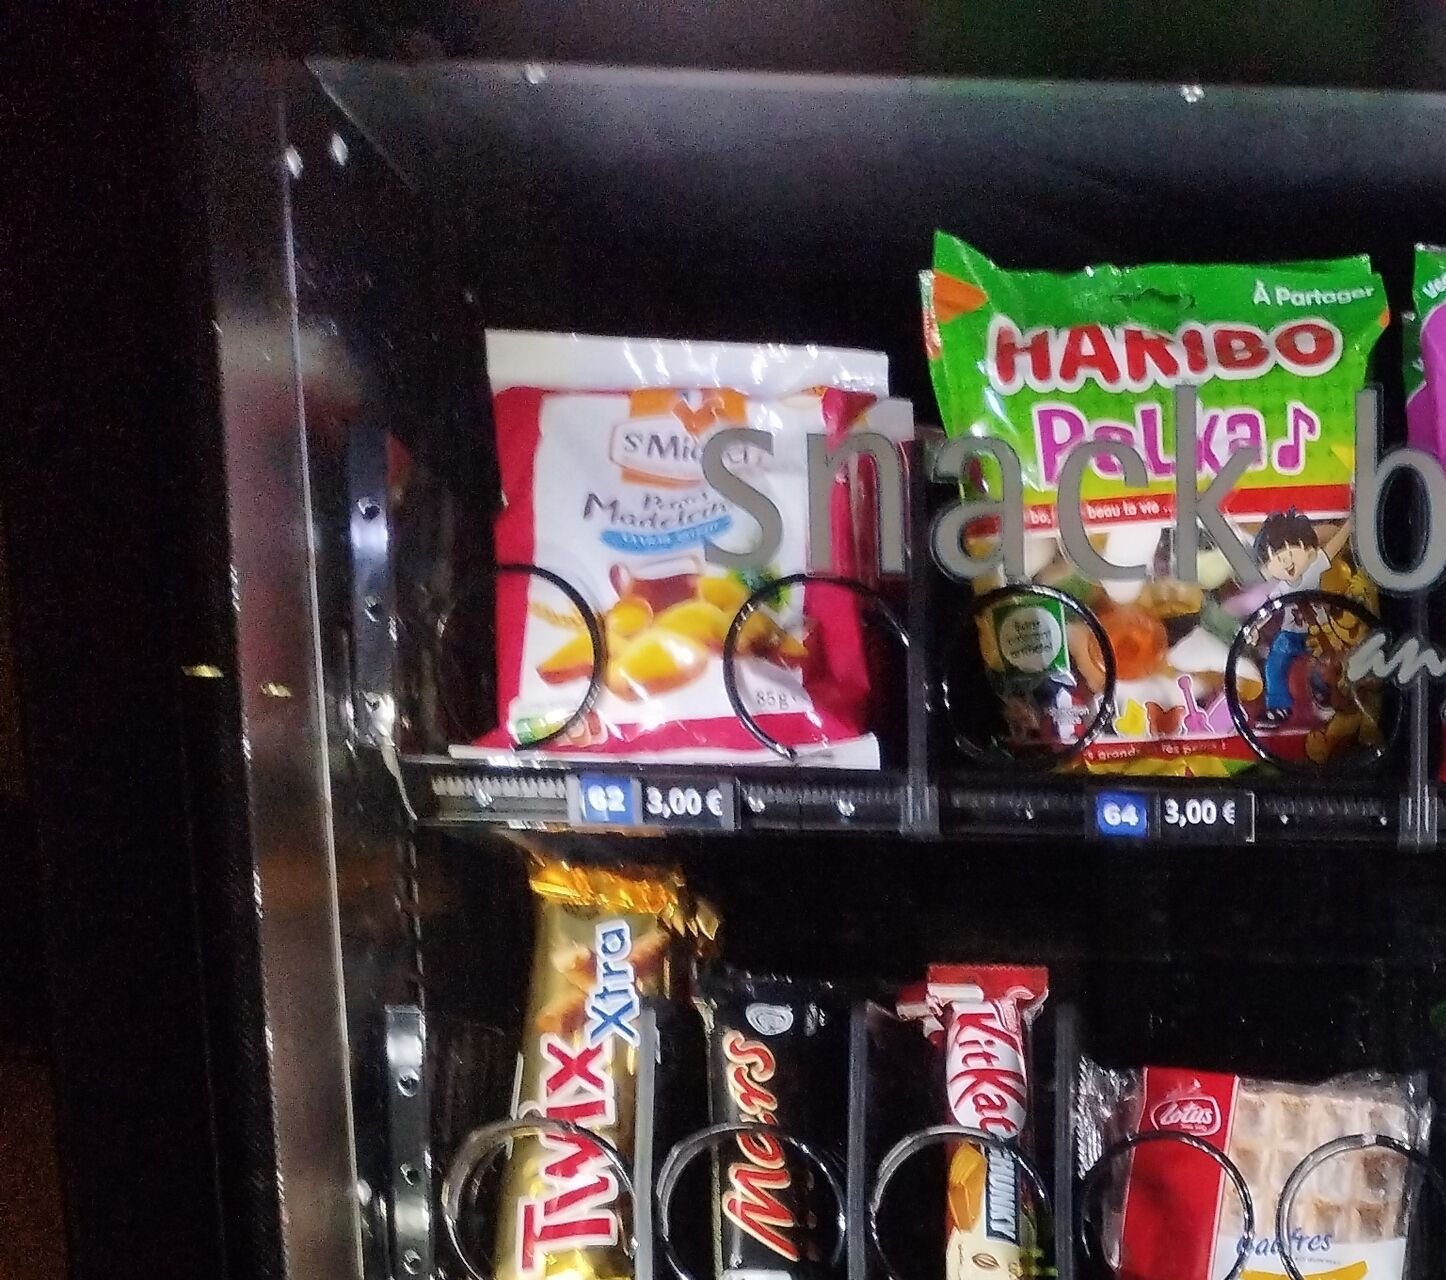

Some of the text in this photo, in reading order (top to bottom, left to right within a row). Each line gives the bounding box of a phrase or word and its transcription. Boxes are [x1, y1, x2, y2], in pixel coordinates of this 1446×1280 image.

[990, 318, 1341, 388] HARIBO
[700, 384, 1277, 584] snack
[647, 786, 703, 819] 3,00
[1103, 798, 1236, 828] 64 3,00 €
